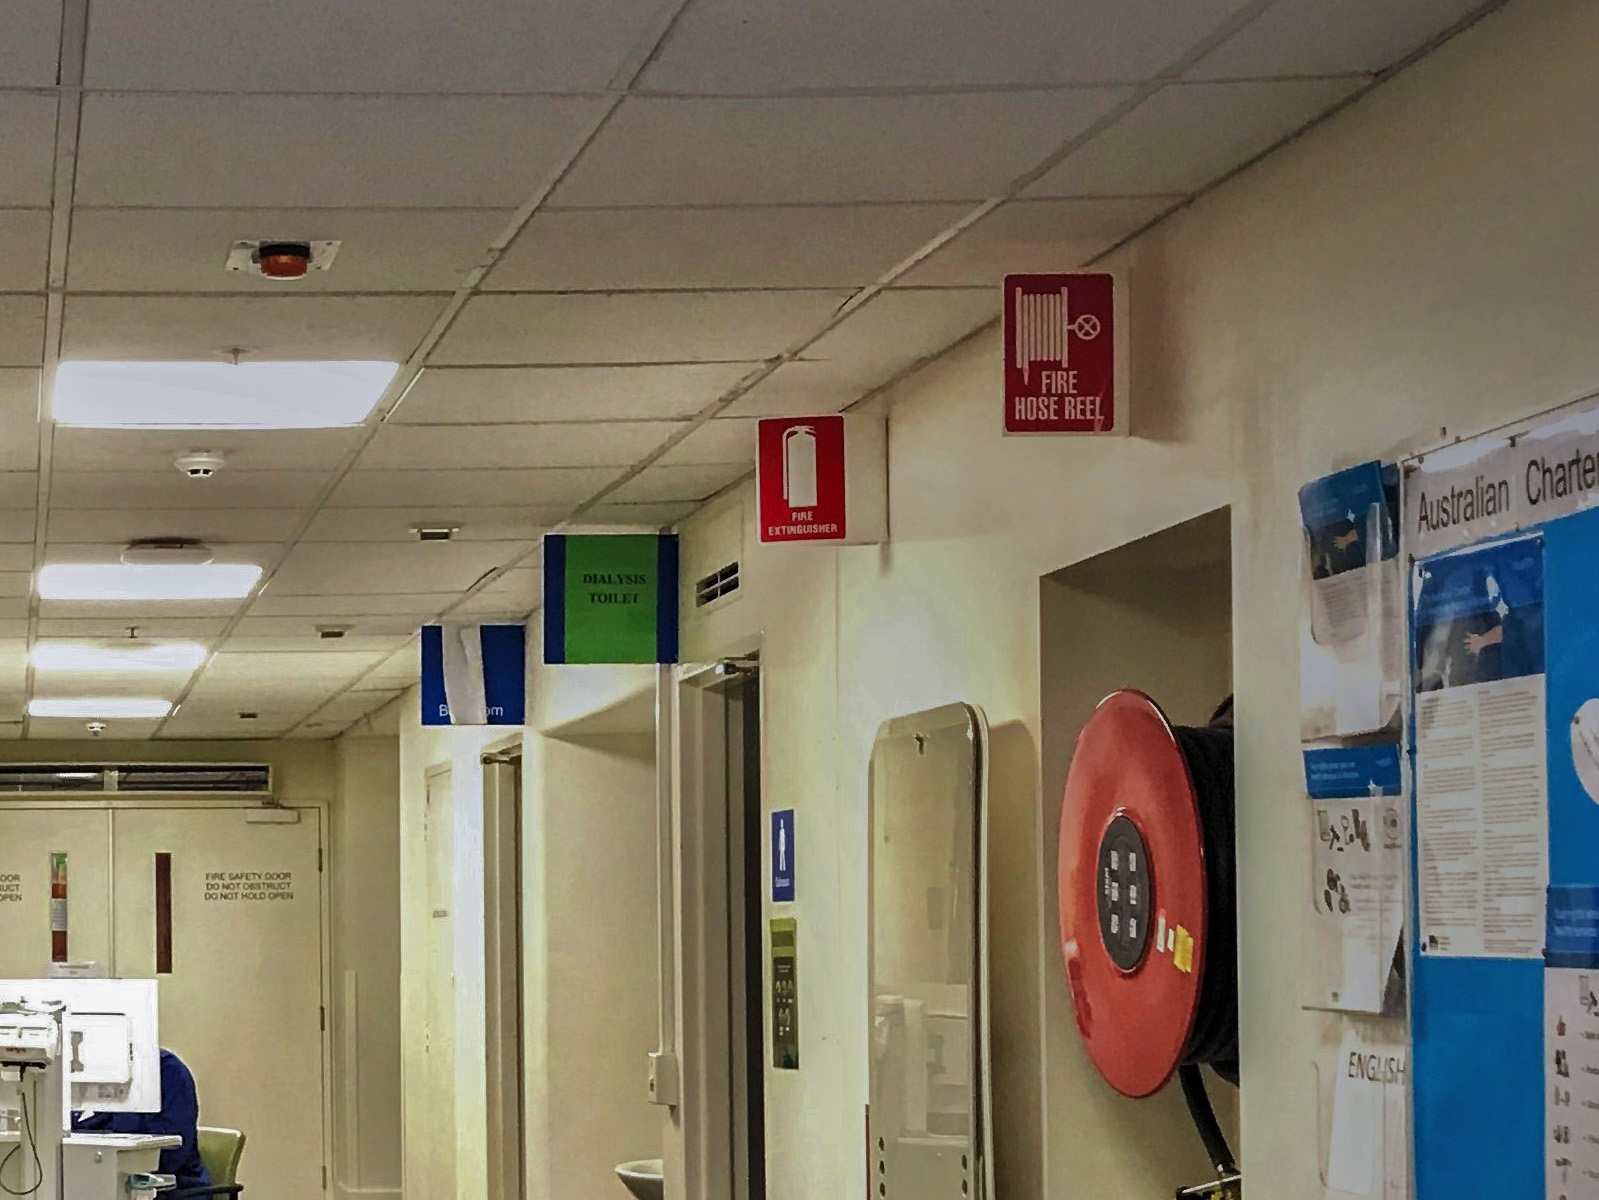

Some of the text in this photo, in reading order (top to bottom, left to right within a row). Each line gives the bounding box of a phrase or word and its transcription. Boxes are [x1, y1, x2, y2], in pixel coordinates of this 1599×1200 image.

[1042, 371, 1078, 394] FIRE
[1015, 396, 1105, 420] HOSE REEL
[1418, 475, 1509, 534] Australian
[791, 511, 813, 522] FIRE
[768, 523, 838, 537] EXTINGUISHER
[583, 573, 647, 585] DIALYSIS
[588, 592, 639, 605] TOILET
[206, 872, 292, 880] FIRE SAFETY DOOR
[206, 882, 291, 890] DO NOT OBSTRUCT
[204, 892, 294, 900] DO NOT HOLD OPEN
[1348, 1051, 1405, 1086] ENGLISH
